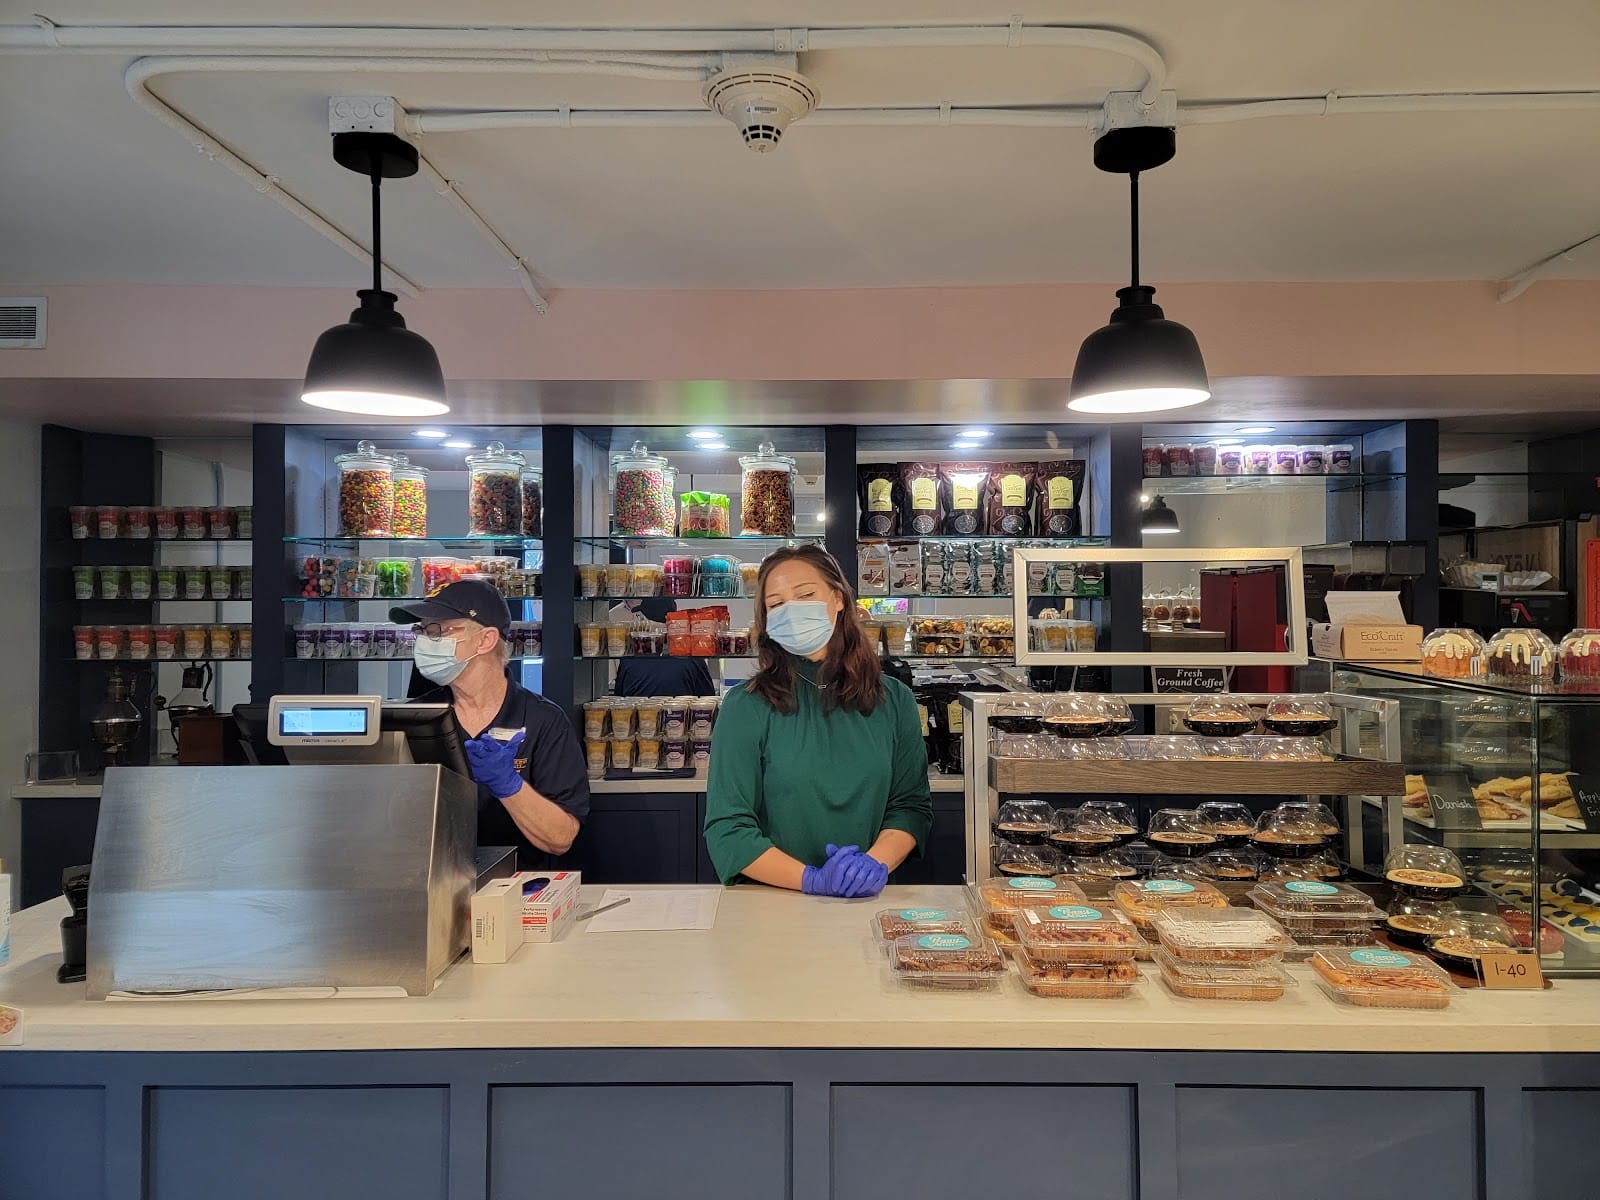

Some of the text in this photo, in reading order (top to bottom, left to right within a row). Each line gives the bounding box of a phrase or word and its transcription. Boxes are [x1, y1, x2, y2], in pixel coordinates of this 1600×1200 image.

[1177, 669, 1203, 678] Fresh
[1158, 677, 1224, 689] Ground Coffee
[1432, 794, 1473, 810] Danish
[1579, 790, 1600, 803] Appl
